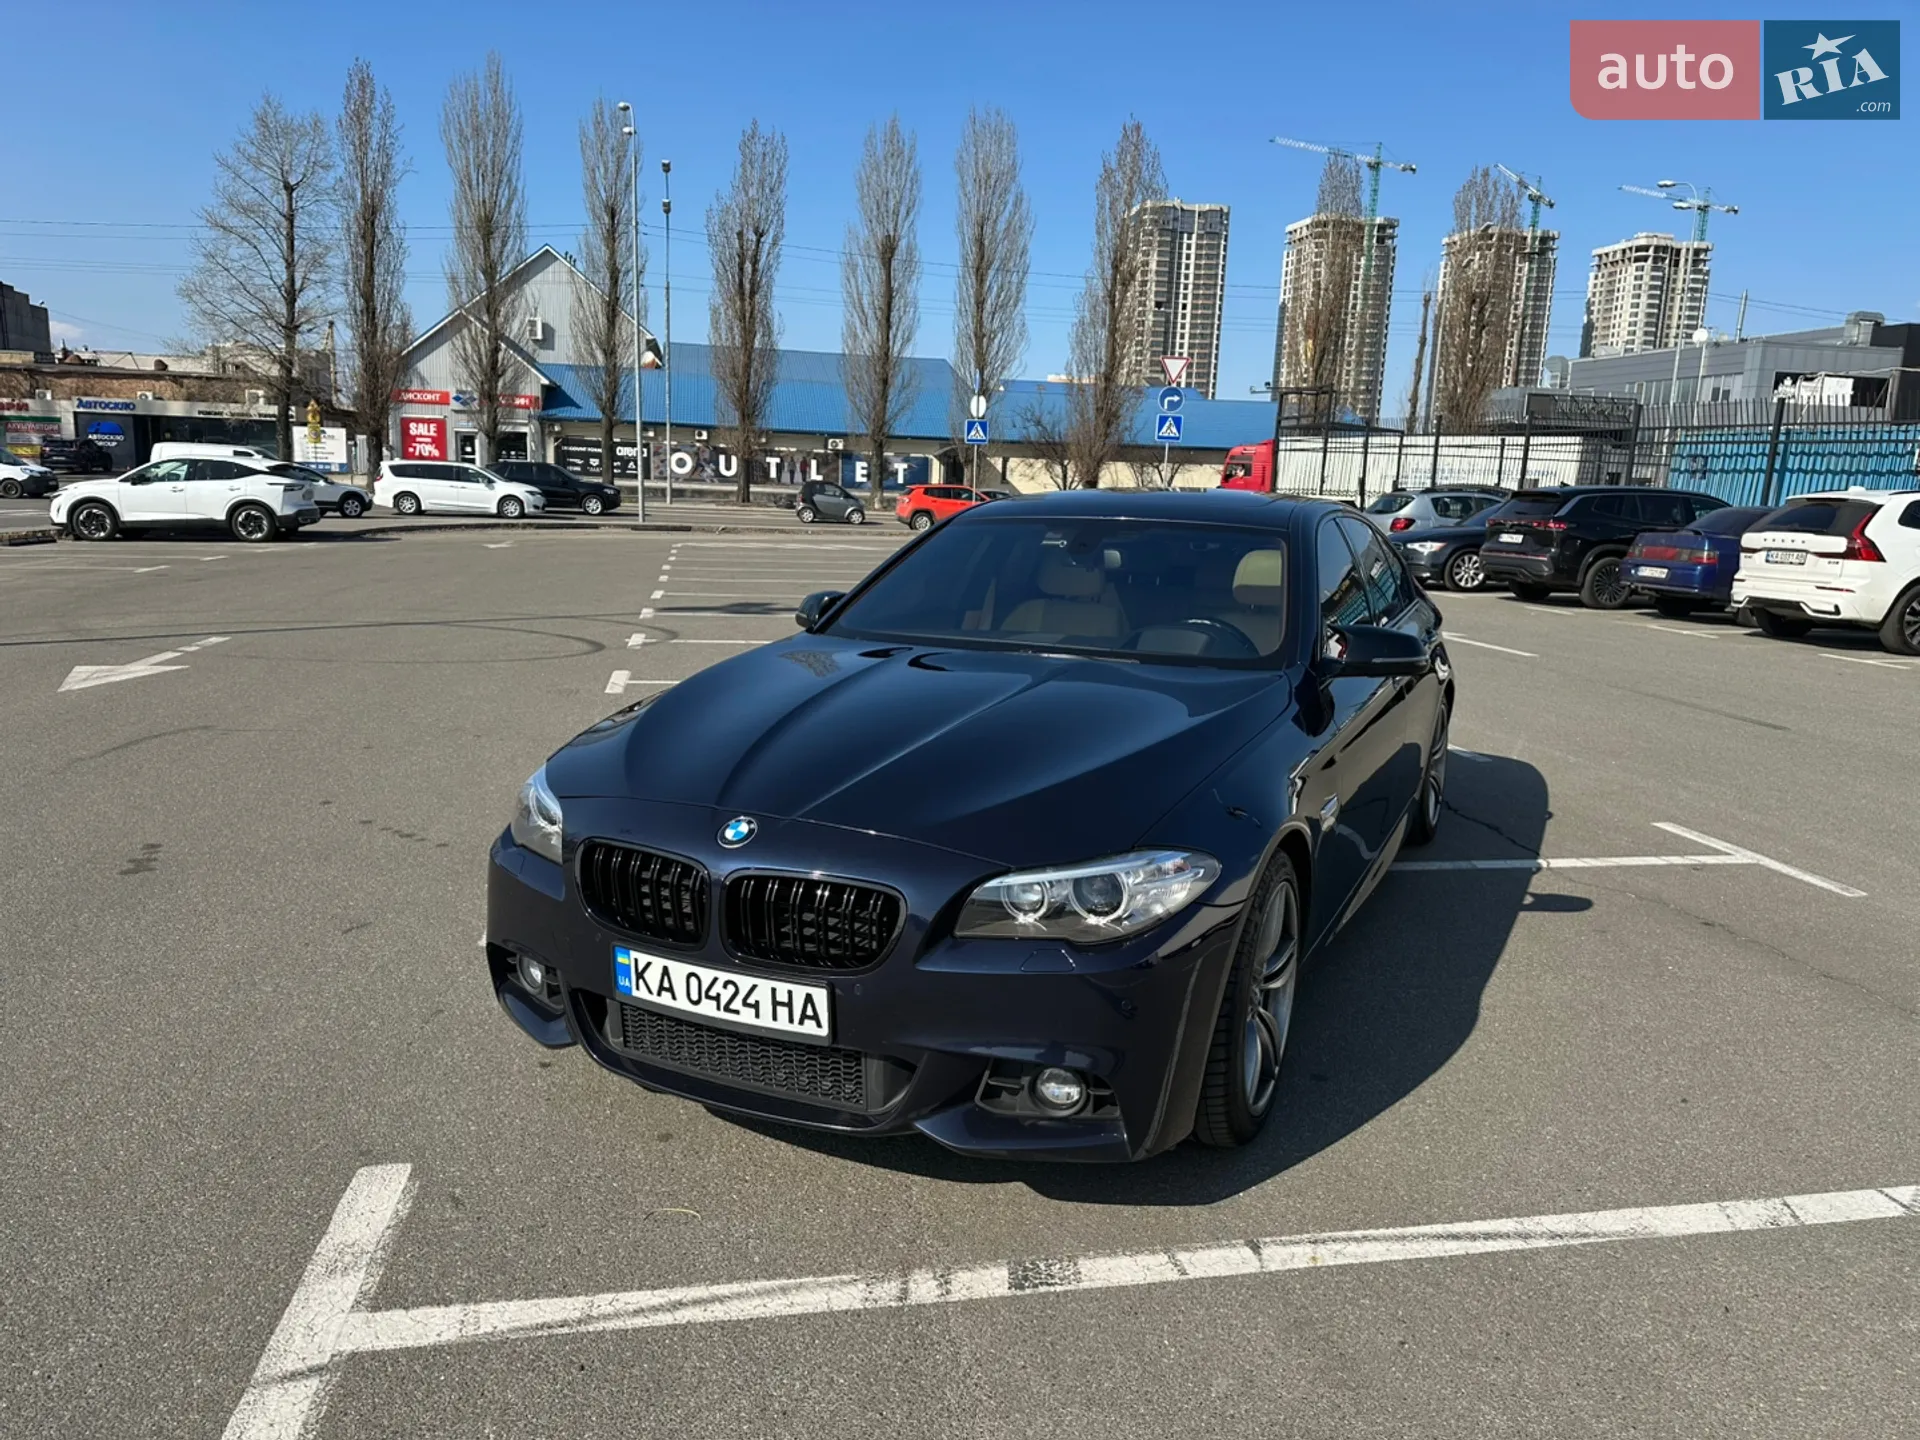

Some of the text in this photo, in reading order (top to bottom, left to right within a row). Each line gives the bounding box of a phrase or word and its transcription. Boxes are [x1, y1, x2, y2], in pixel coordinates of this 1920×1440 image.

[408, 422, 437, 437] SALE
[408, 442, 440, 458] -70%
[618, 975, 631, 988] UA
[634, 957, 823, 1029] KA 0424 HA
